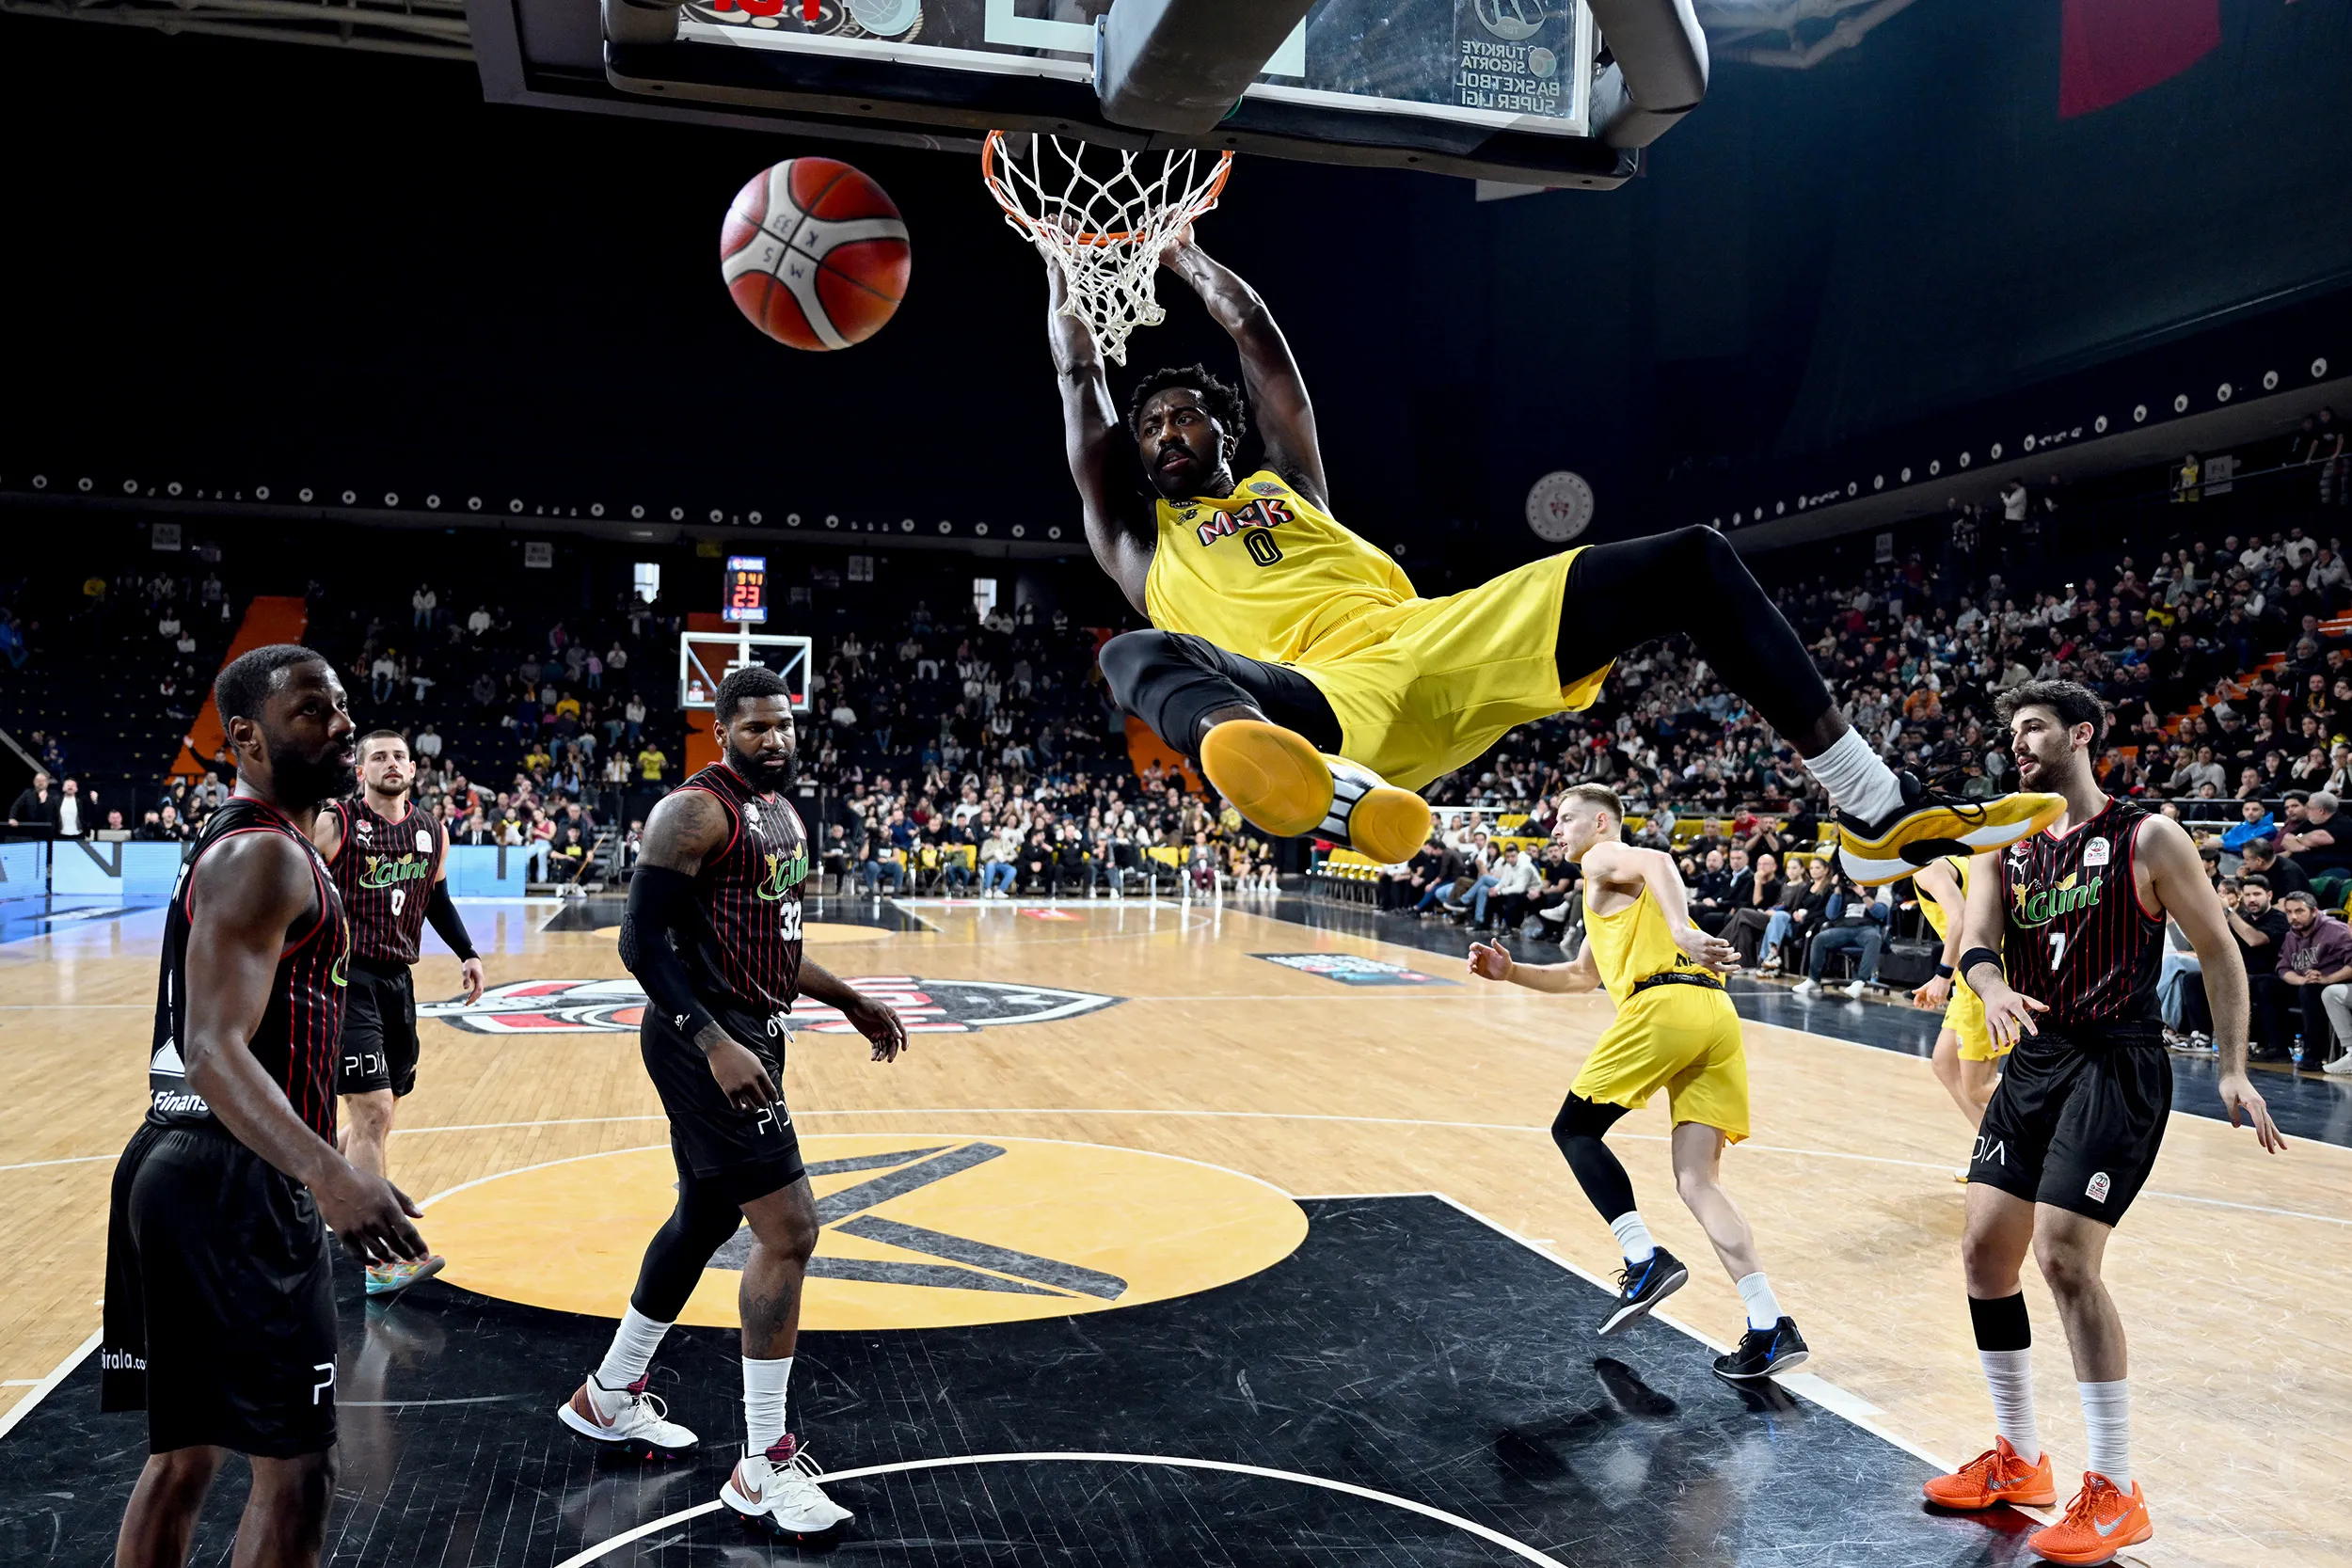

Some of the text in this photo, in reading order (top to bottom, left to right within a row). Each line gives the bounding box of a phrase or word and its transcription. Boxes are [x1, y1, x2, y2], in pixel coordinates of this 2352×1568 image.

[1243, 528, 1283, 566] 0
[732, 585, 760, 609] 23
[374, 856, 428, 884] Glint
[391, 888, 405, 916] 0
[2027, 875, 2103, 922] Glint
[780, 900, 803, 942] 32
[2048, 932, 2066, 971] 7
[102, 1348, 147, 1370] irala.co
